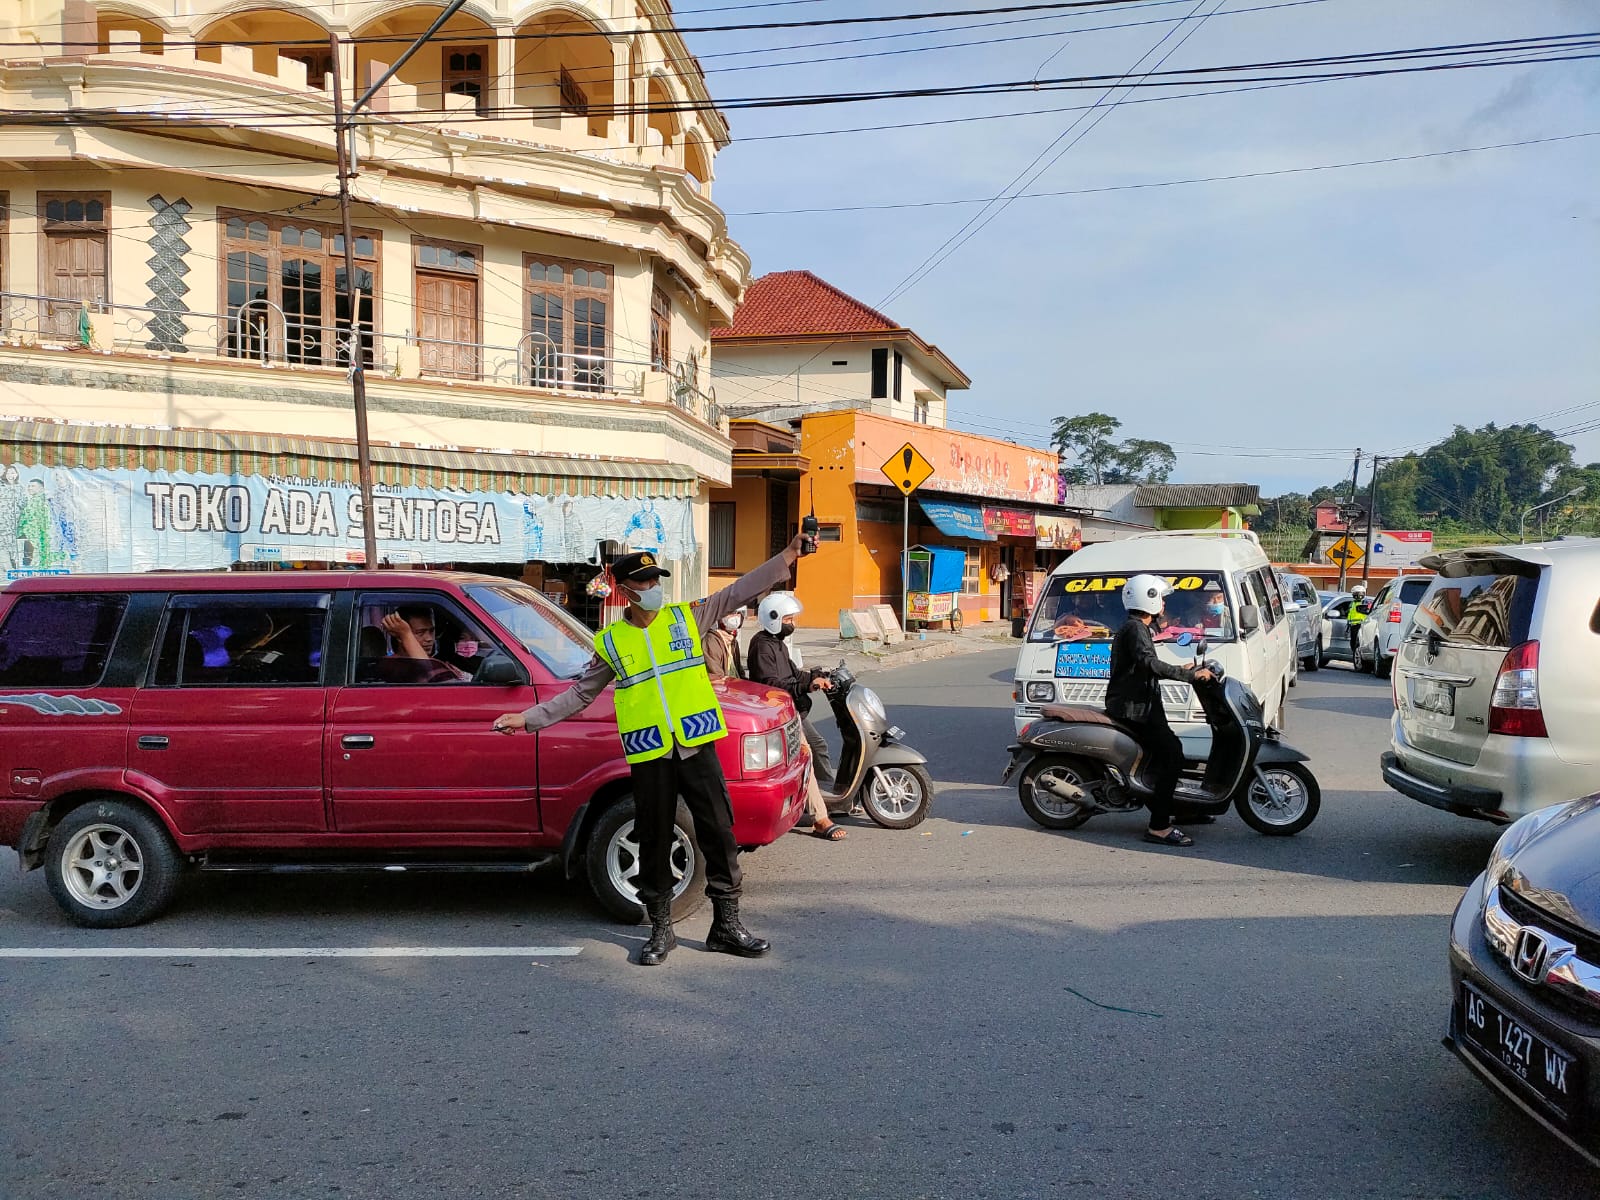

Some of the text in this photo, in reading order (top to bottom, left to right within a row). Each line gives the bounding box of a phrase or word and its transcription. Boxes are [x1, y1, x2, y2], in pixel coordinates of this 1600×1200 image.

[145, 482, 501, 544] TOKO ADA SENTOSA
[1468, 992, 1567, 1095] AG 1427 WX
